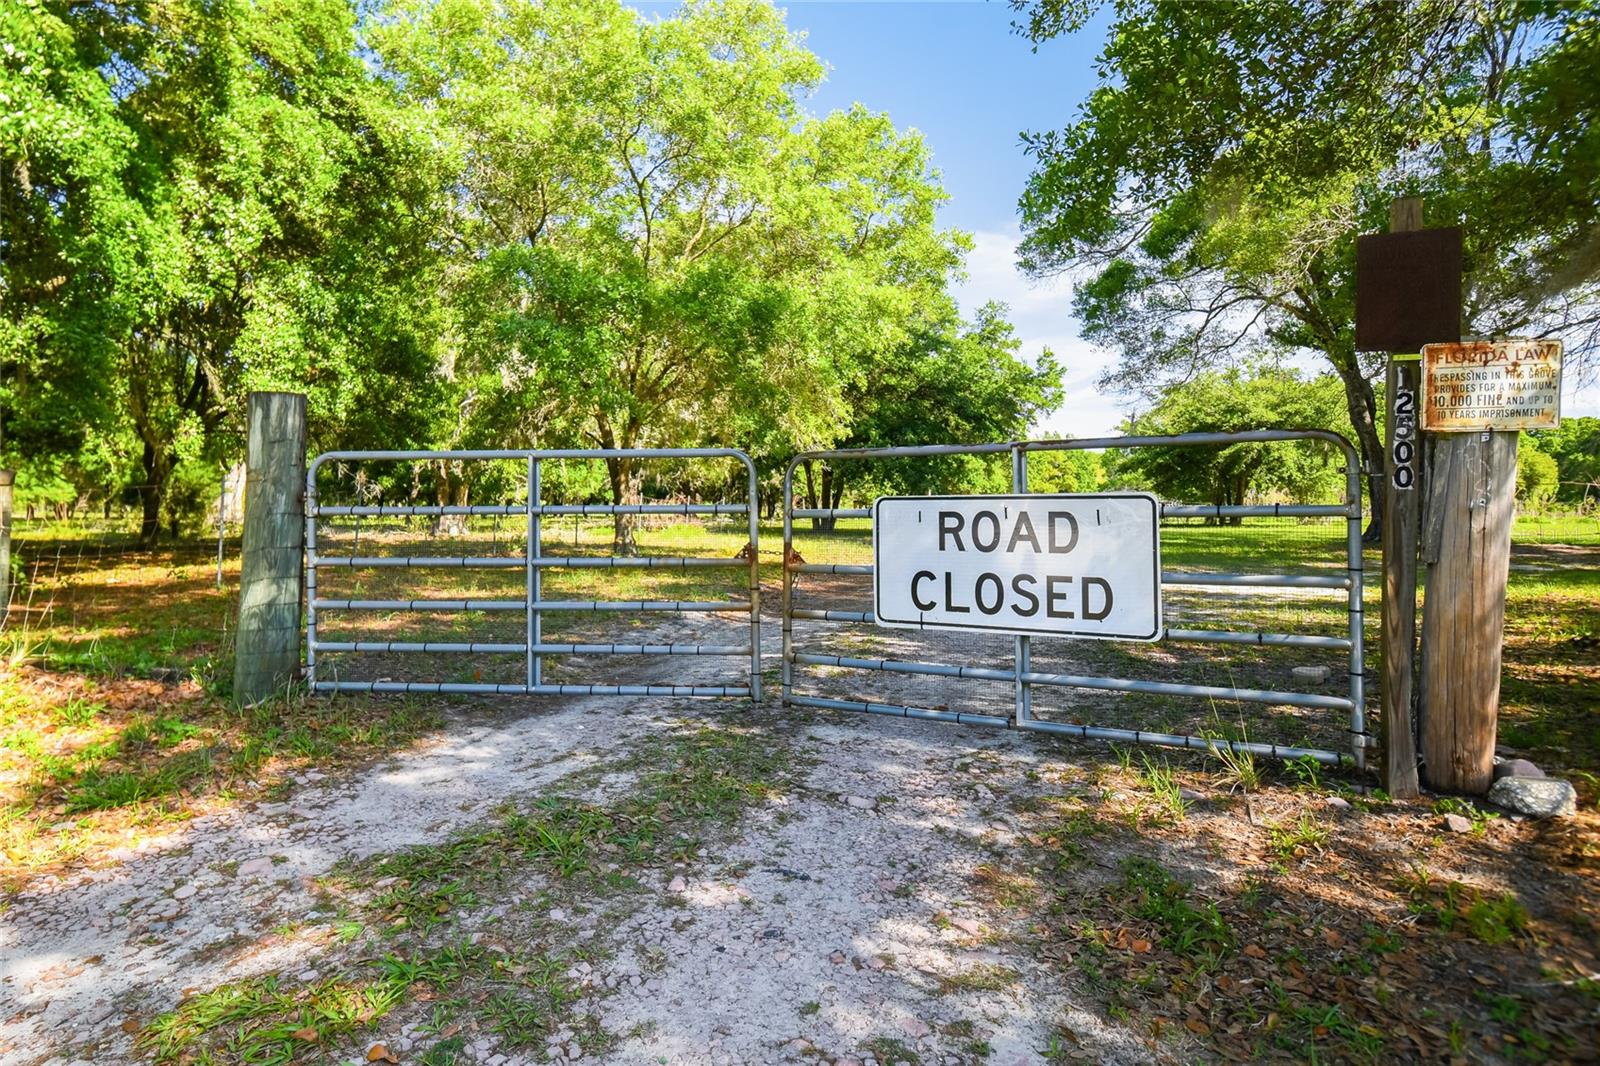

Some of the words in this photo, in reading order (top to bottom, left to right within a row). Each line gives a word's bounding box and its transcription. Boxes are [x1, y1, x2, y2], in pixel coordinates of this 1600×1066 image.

[1436, 349, 1508, 364] FLORIDA
[1516, 346, 1550, 361] LAW
[1491, 370, 1501, 380] IN
[1528, 368, 1557, 379] GROVE
[1434, 384, 1476, 394] PROVIDES
[1479, 383, 1496, 393] FOR
[1499, 382, 1505, 392] A
[1477, 393, 1503, 406] FINE
[1506, 395, 1526, 405] AND
[1529, 395, 1540, 405] UP
[1543, 394, 1553, 405] TO
[1438, 410, 1446, 420] 10
[1449, 409, 1476, 419] YEARS
[1479, 407, 1545, 418] IMPRISONMENT
[938, 510, 1080, 554] ROAD
[911, 570, 1114, 621] CLOSED
